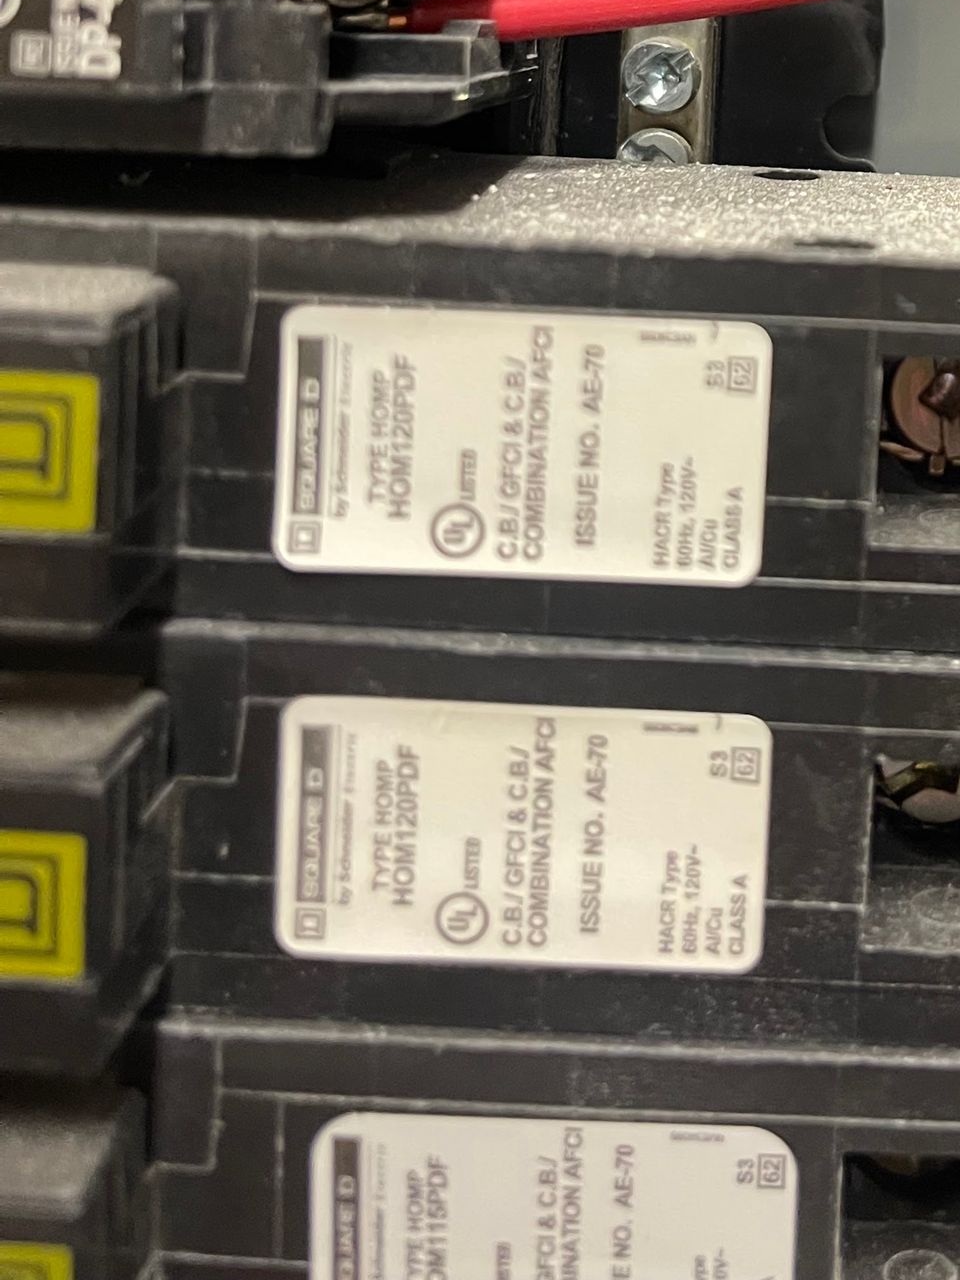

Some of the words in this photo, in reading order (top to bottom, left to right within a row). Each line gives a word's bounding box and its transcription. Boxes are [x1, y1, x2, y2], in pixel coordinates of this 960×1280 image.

[533, 325, 553, 383] AFCI
[583, 344, 605, 413] AE-70
[303, 377, 320, 402] D
[371, 370, 391, 438] HOMP
[389, 354, 416, 519] HOM120PDF
[504, 421, 523, 435] &
[579, 424, 599, 468] NO.
[300, 407, 319, 510] SQUARE
[368, 443, 388, 504] TYPE
[460, 449, 477, 501] LISTED
[500, 442, 522, 498] GFCI
[524, 389, 549, 560] COMBINATION
[657, 463, 677, 507] Type
[575, 474, 598, 546] ISSUE
[727, 486, 743, 501] A
[654, 511, 672, 567] HACR
[724, 504, 742, 569] CLASS
[535, 717, 556, 771] AFCI
[586, 734, 608, 802] AE-70
[710, 750, 728, 777] S3
[736, 752, 754, 776] 62
[305, 768, 323, 791] D
[375, 760, 394, 825] HOMP
[393, 744, 420, 906] HOM120PDF
[507, 808, 527, 823] &
[584, 813, 604, 856] NO.
[303, 797, 322, 898] SQUARE
[372, 832, 392, 892] TYPE
[465, 837, 481, 890] LISTED
[505, 830, 526, 887] GFCI
[527, 778, 553, 946] COMBINATION
[662, 850, 679, 895] Type
[580, 862, 602, 934] ISSUE
[733, 874, 748, 889] A
[659, 901, 675, 954] HACR
[682, 906, 701, 954] 60Hz,
[729, 893, 747, 955] CLASS
[564, 1127, 583, 1180] AFCI
[614, 1145, 634, 1208] AE-70
[736, 1159, 754, 1183] S3
[763, 1160, 780, 1182] 62
[407, 1170, 424, 1232] HOMP
[426, 1154, 447, 1280] OM115PDF
[538, 1214, 556, 1229] &
[337, 1203, 355, 1280] QUARE
[561, 1187, 580, 1280] INATION
[613, 1221, 632, 1259] NO.
